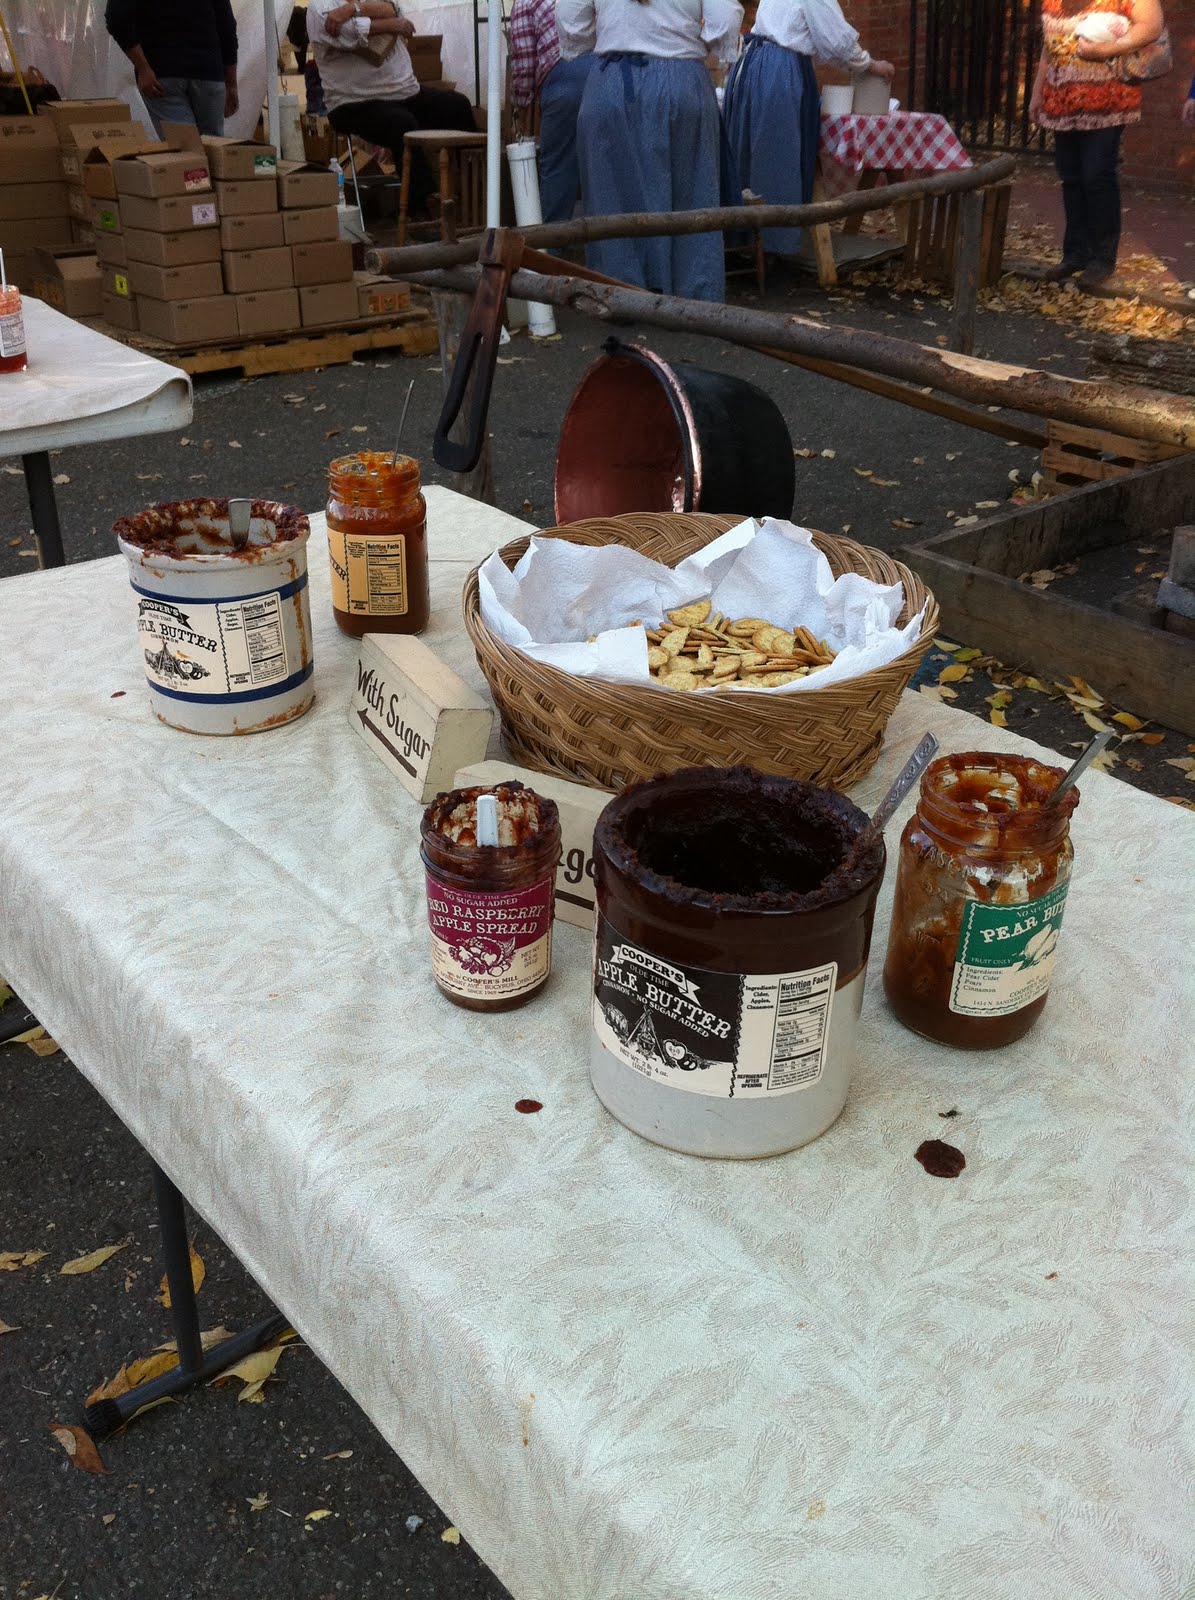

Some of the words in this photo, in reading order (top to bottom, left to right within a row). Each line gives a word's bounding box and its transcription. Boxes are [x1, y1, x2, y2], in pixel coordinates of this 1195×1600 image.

[142, 601, 179, 616] COOPER'S
[264, 600, 276, 608] Facts
[159, 623, 218, 652] BUTTER
[357, 659, 386, 717] With
[386, 694, 431, 760] Sugar
[428, 898, 449, 914] RED
[452, 904, 545, 920] RASPBERRY
[443, 892, 455, 901] NO
[456, 896, 485, 907] SUGAR
[488, 898, 518, 907] ADDED
[432, 914, 472, 933] APPLE
[476, 922, 538, 935] SPREAD
[980, 916, 1038, 943] PEAR
[621, 947, 684, 983] COOPER'S
[630, 963, 649, 979] OLDE
[650, 974, 669, 988] TIME
[462, 976, 500, 985] COOPER'S
[501, 975, 519, 983] MILL
[780, 979, 811, 991] Nutrition
[812, 974, 830, 986] Facts
[598, 958, 638, 992] APPLE
[645, 982, 731, 1039] BUTTER
[602, 980, 630, 997] CINNAMON
[636, 993, 648, 1005] NO
[649, 1001, 678, 1020] SUGAR
[678, 1017, 710, 1038] ADDED
[619, 1047, 630, 1058] NET
